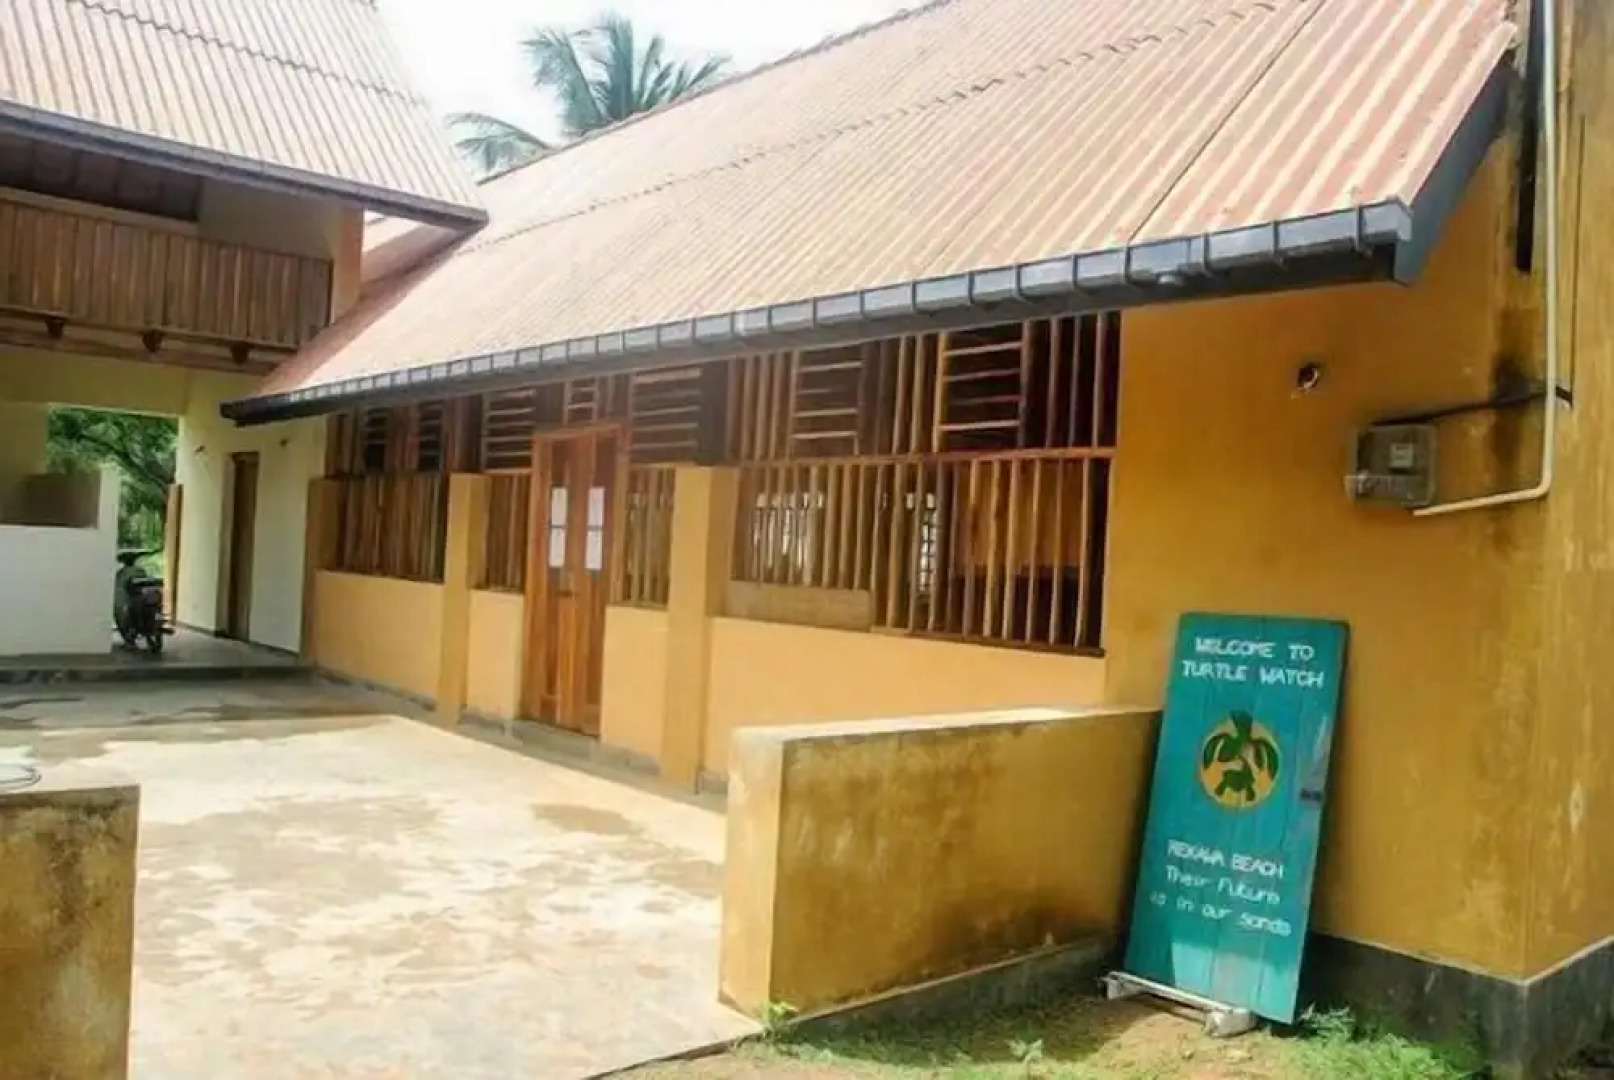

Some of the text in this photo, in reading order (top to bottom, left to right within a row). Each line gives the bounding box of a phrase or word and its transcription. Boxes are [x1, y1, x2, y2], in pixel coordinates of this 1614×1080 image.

[1195, 636, 1315, 660] WELCOME TO
[1182, 660, 1325, 689] TURTLE WATCH
[1232, 854, 1284, 878] BEACH
